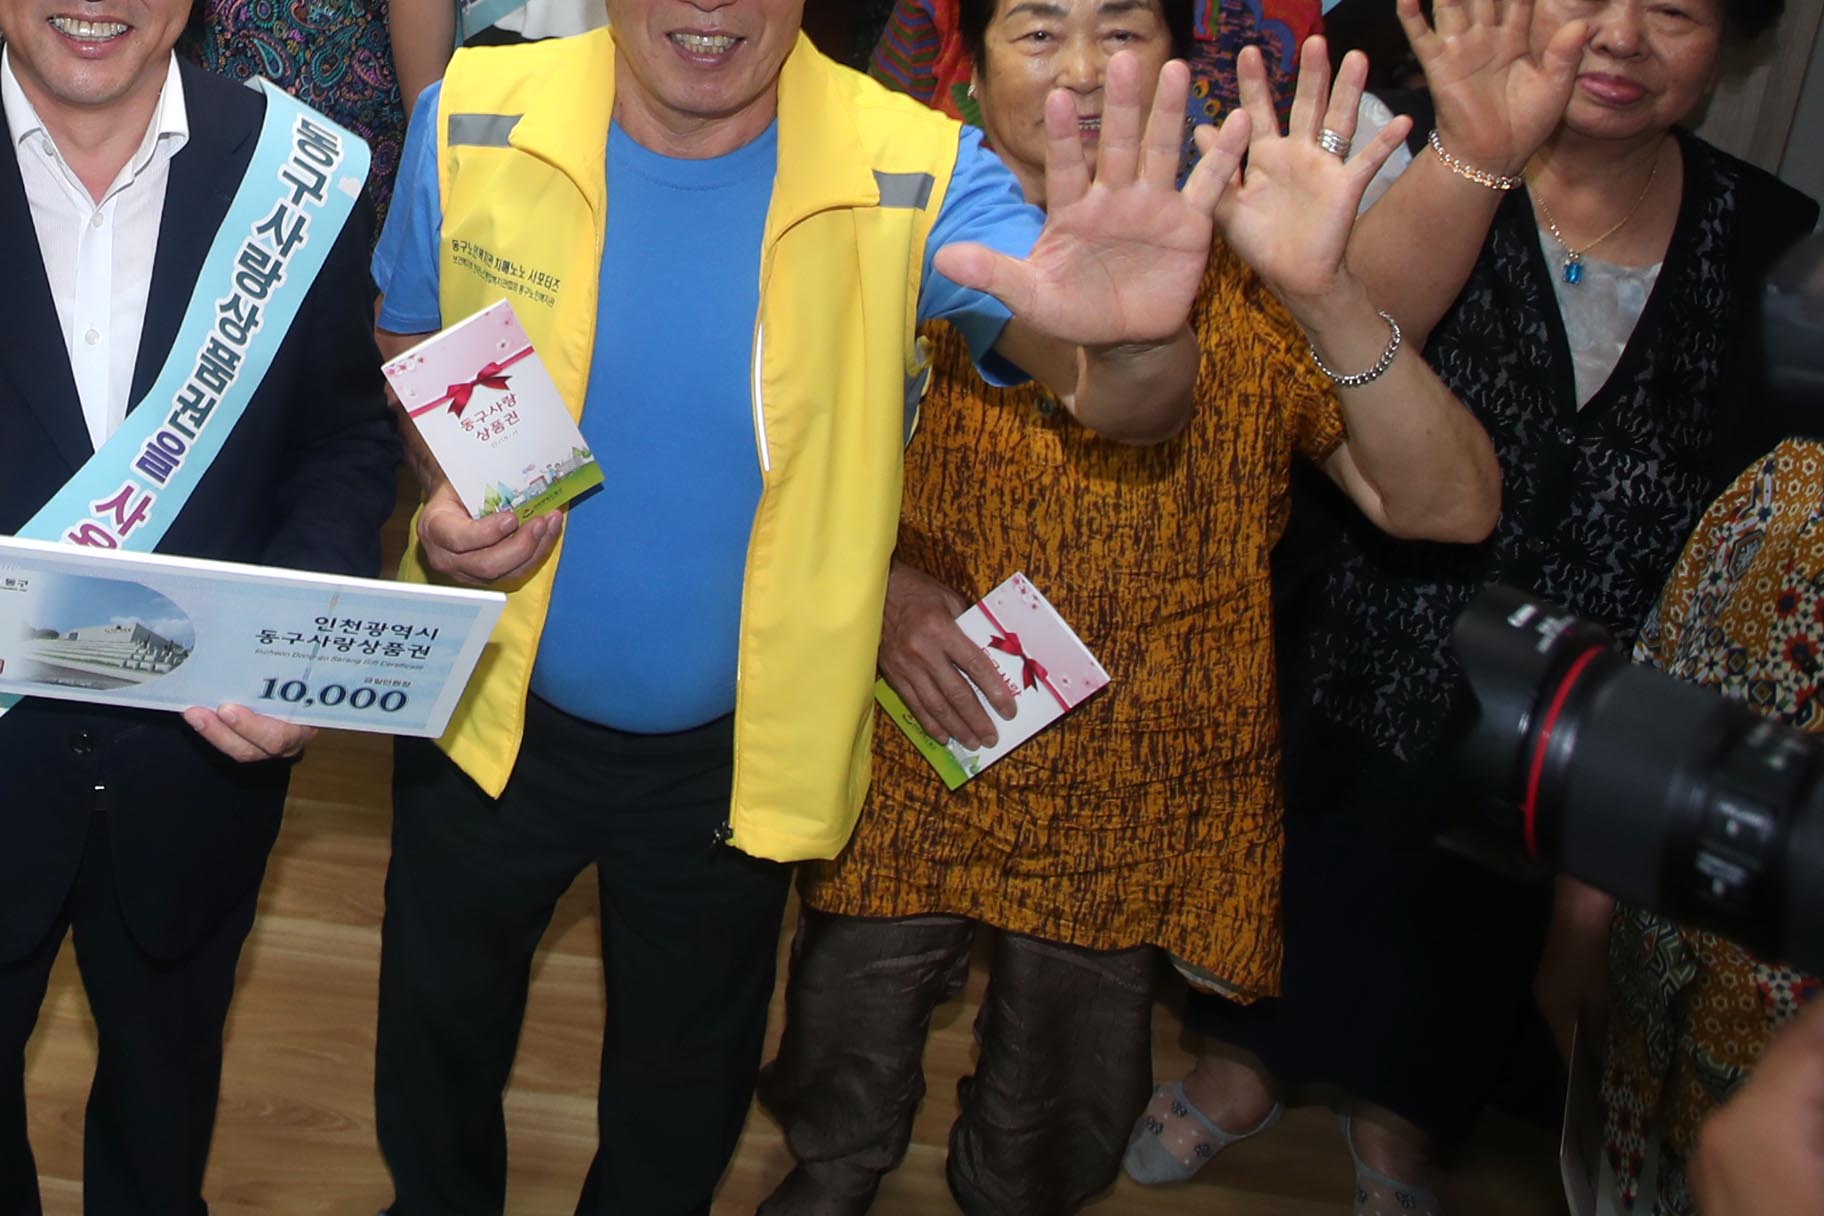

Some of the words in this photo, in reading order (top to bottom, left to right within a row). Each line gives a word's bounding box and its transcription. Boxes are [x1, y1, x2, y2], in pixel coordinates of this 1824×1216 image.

[135, 117, 341, 484] 동구사랑상품권을
[460, 392, 518, 433] 동구사랑
[476, 410, 521, 443] 상품권
[255, 628, 433, 661] 동구사랑상품권
[314, 616, 440, 642] 인천광역시
[258, 676, 409, 713] 10,000
